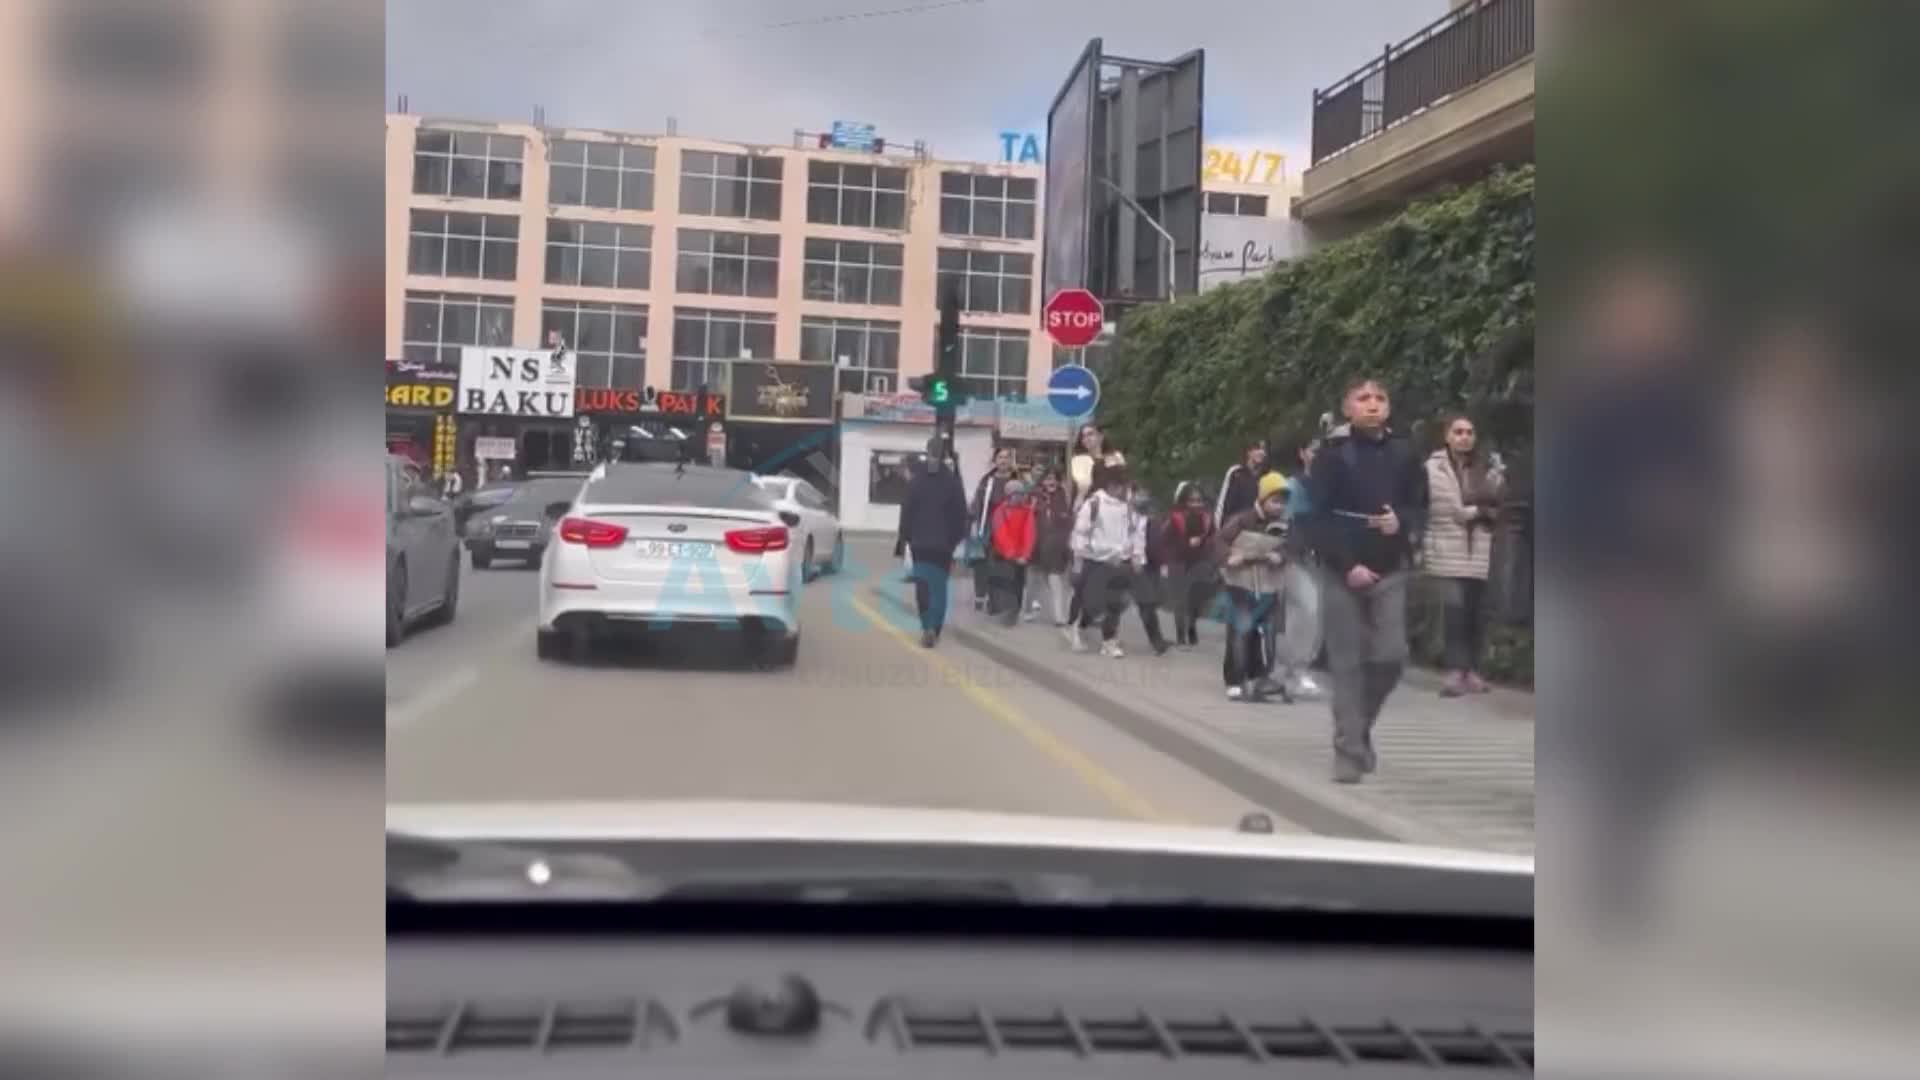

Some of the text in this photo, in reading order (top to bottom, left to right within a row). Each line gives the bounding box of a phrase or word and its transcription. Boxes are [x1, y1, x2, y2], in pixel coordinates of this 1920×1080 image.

[1203, 148, 1284, 184] 24/7
[1048, 310, 1101, 329] STOP
[489, 355, 541, 382] NS
[386, 384, 454, 406] ARD
[466, 388, 569, 415] BAKU
[578, 390, 640, 412] LUKS
